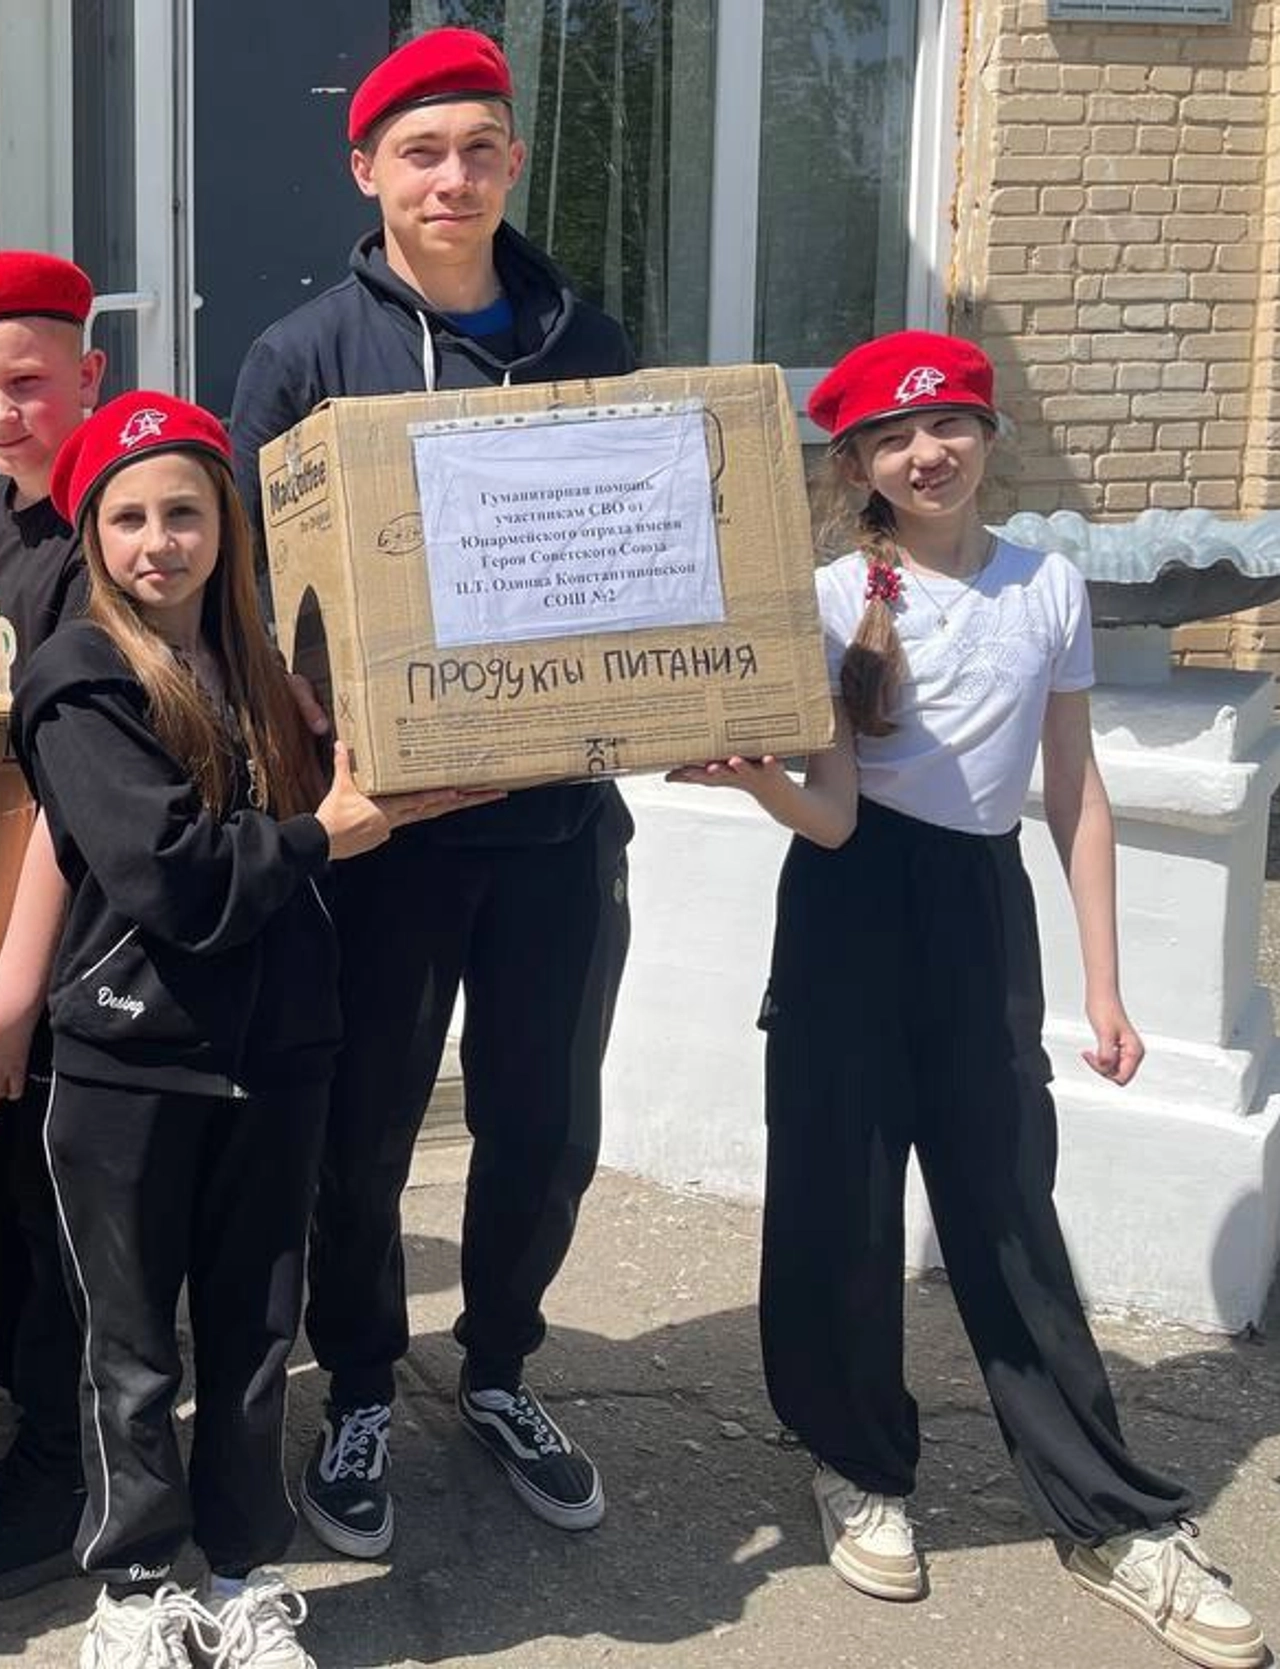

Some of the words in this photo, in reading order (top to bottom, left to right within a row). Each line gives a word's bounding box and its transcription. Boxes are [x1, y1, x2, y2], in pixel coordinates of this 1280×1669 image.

[481, 488, 591, 508] Гуманитарная
[595, 480, 654, 496] помощь
[494, 509, 585, 527] участникам
[589, 503, 625, 516] СВО
[461, 529, 577, 550] Юнармейского
[581, 524, 634, 541] отряда
[636, 520, 683, 534] имени
[481, 553, 527, 570] Героя
[531, 546, 617, 564] Советского
[620, 540, 668, 556] Союза
[555, 562, 697, 587] Константиновской
[543, 593, 586, 609] СОШ
[590, 588, 618, 605] №2
[602, 643, 758, 683] ПИТАНИЯ
